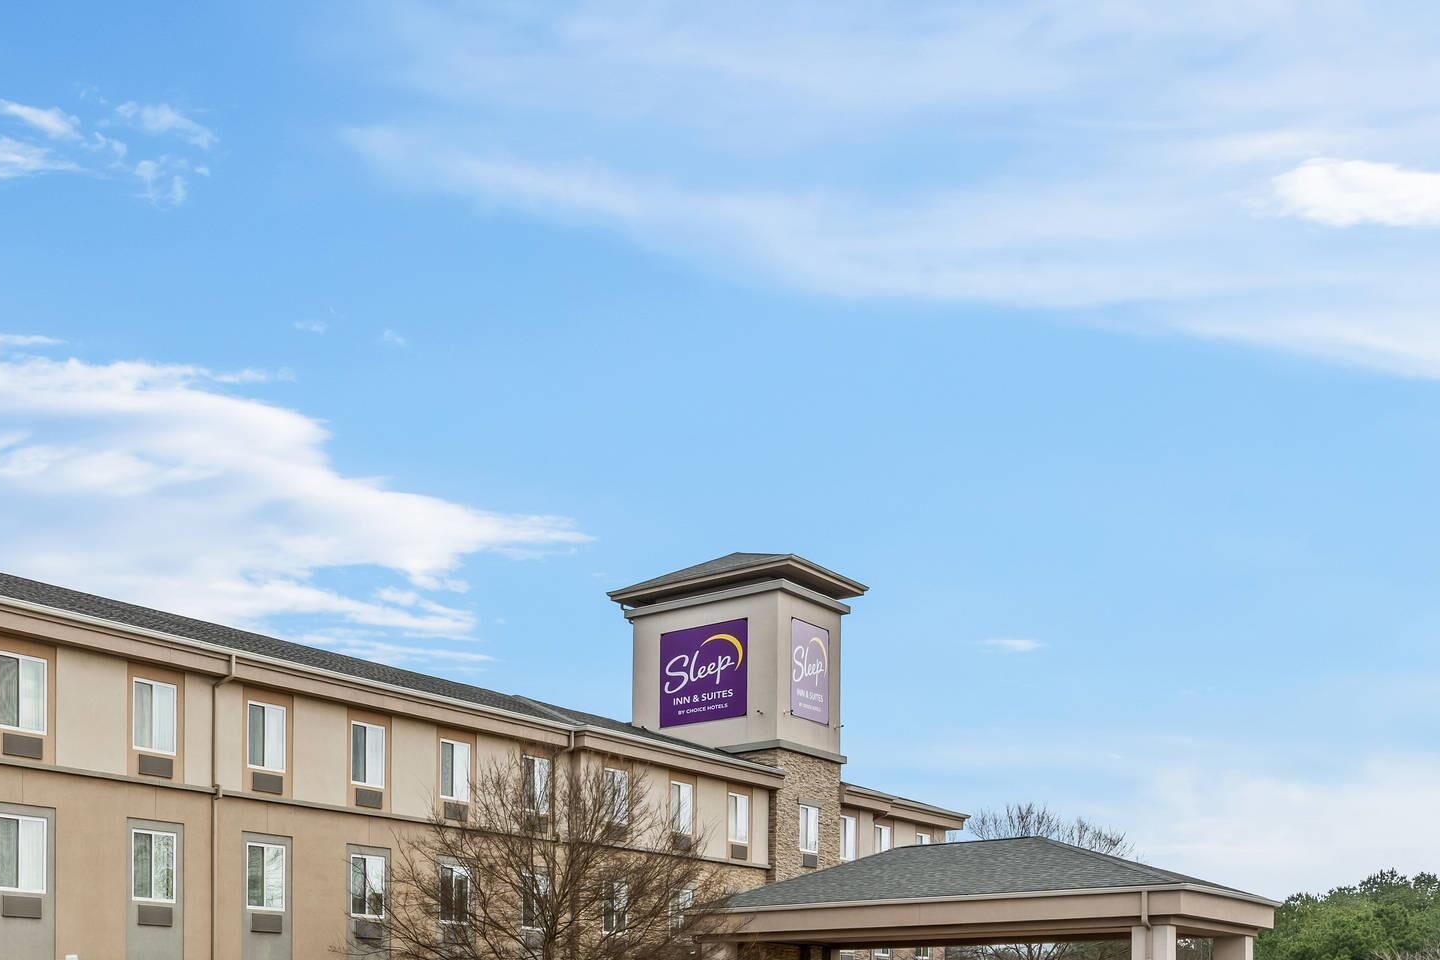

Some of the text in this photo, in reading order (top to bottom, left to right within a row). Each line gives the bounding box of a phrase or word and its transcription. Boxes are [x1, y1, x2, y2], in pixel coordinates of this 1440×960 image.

[664, 650, 735, 694] Sleep
[792, 645, 824, 687] Sleep
[673, 689, 734, 705] INN & SUITES
[686, 706, 706, 714] CHOICE
